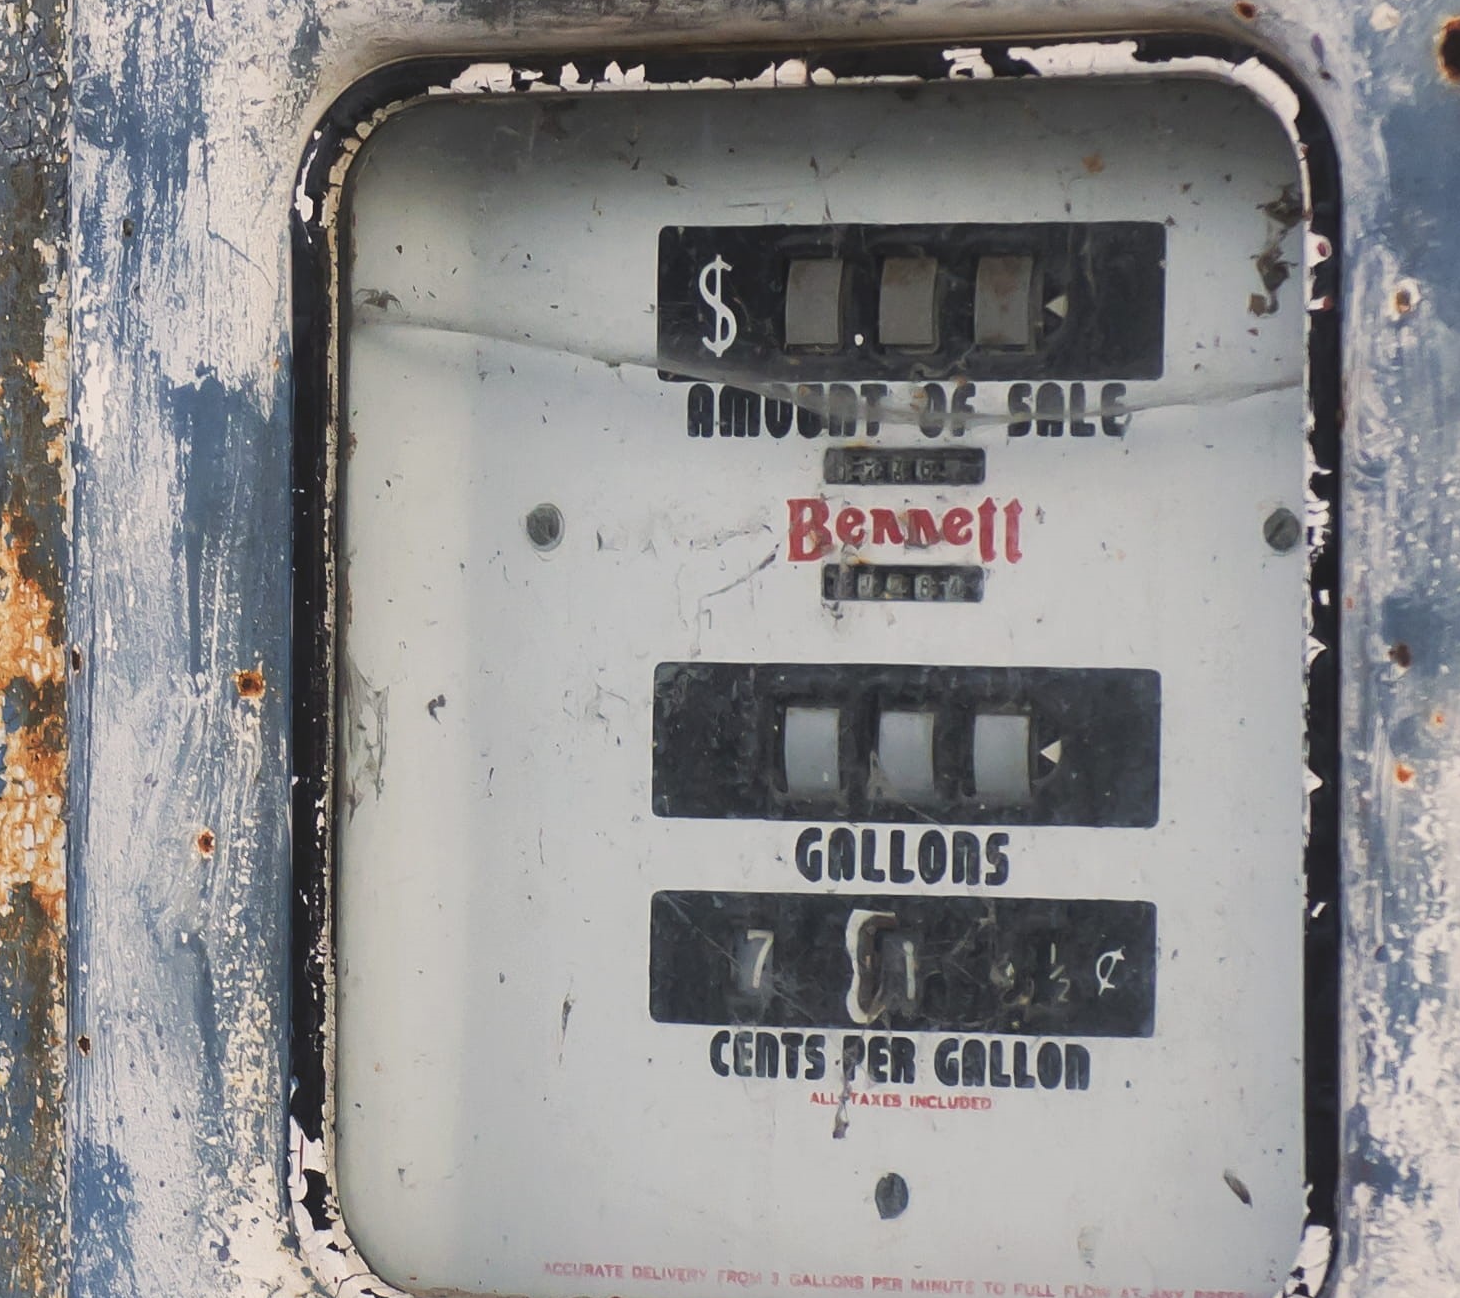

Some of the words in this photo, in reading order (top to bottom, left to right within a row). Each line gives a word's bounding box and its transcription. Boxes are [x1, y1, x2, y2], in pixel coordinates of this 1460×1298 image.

[687, 382, 887, 439] AMOUNT
[919, 382, 976, 438] OF
[1006, 382, 1130, 438] SALE
[787, 497, 1022, 564] Bennett
[795, 827, 1009, 886] GALLONS
[709, 1030, 826, 1081] CENTS
[842, 1035, 916, 1084] PER
[934, 1037, 1091, 1091] GALLON
[810, 1092, 839, 1105] ALL
[850, 1092, 902, 1108] TAXES
[910, 1094, 992, 1110] INCLUDED
[544, 1261, 624, 1278] ACCURATE
[632, 1265, 708, 1283] DELIVERY
[717, 1269, 763, 1287] FROM
[789, 1274, 865, 1290] GALLONS
[871, 1276, 903, 1292] PER
[911, 1278, 975, 1294] MINUTE
[984, 1280, 1006, 1296] TO
[1014, 1282, 1056, 1298] FULL
